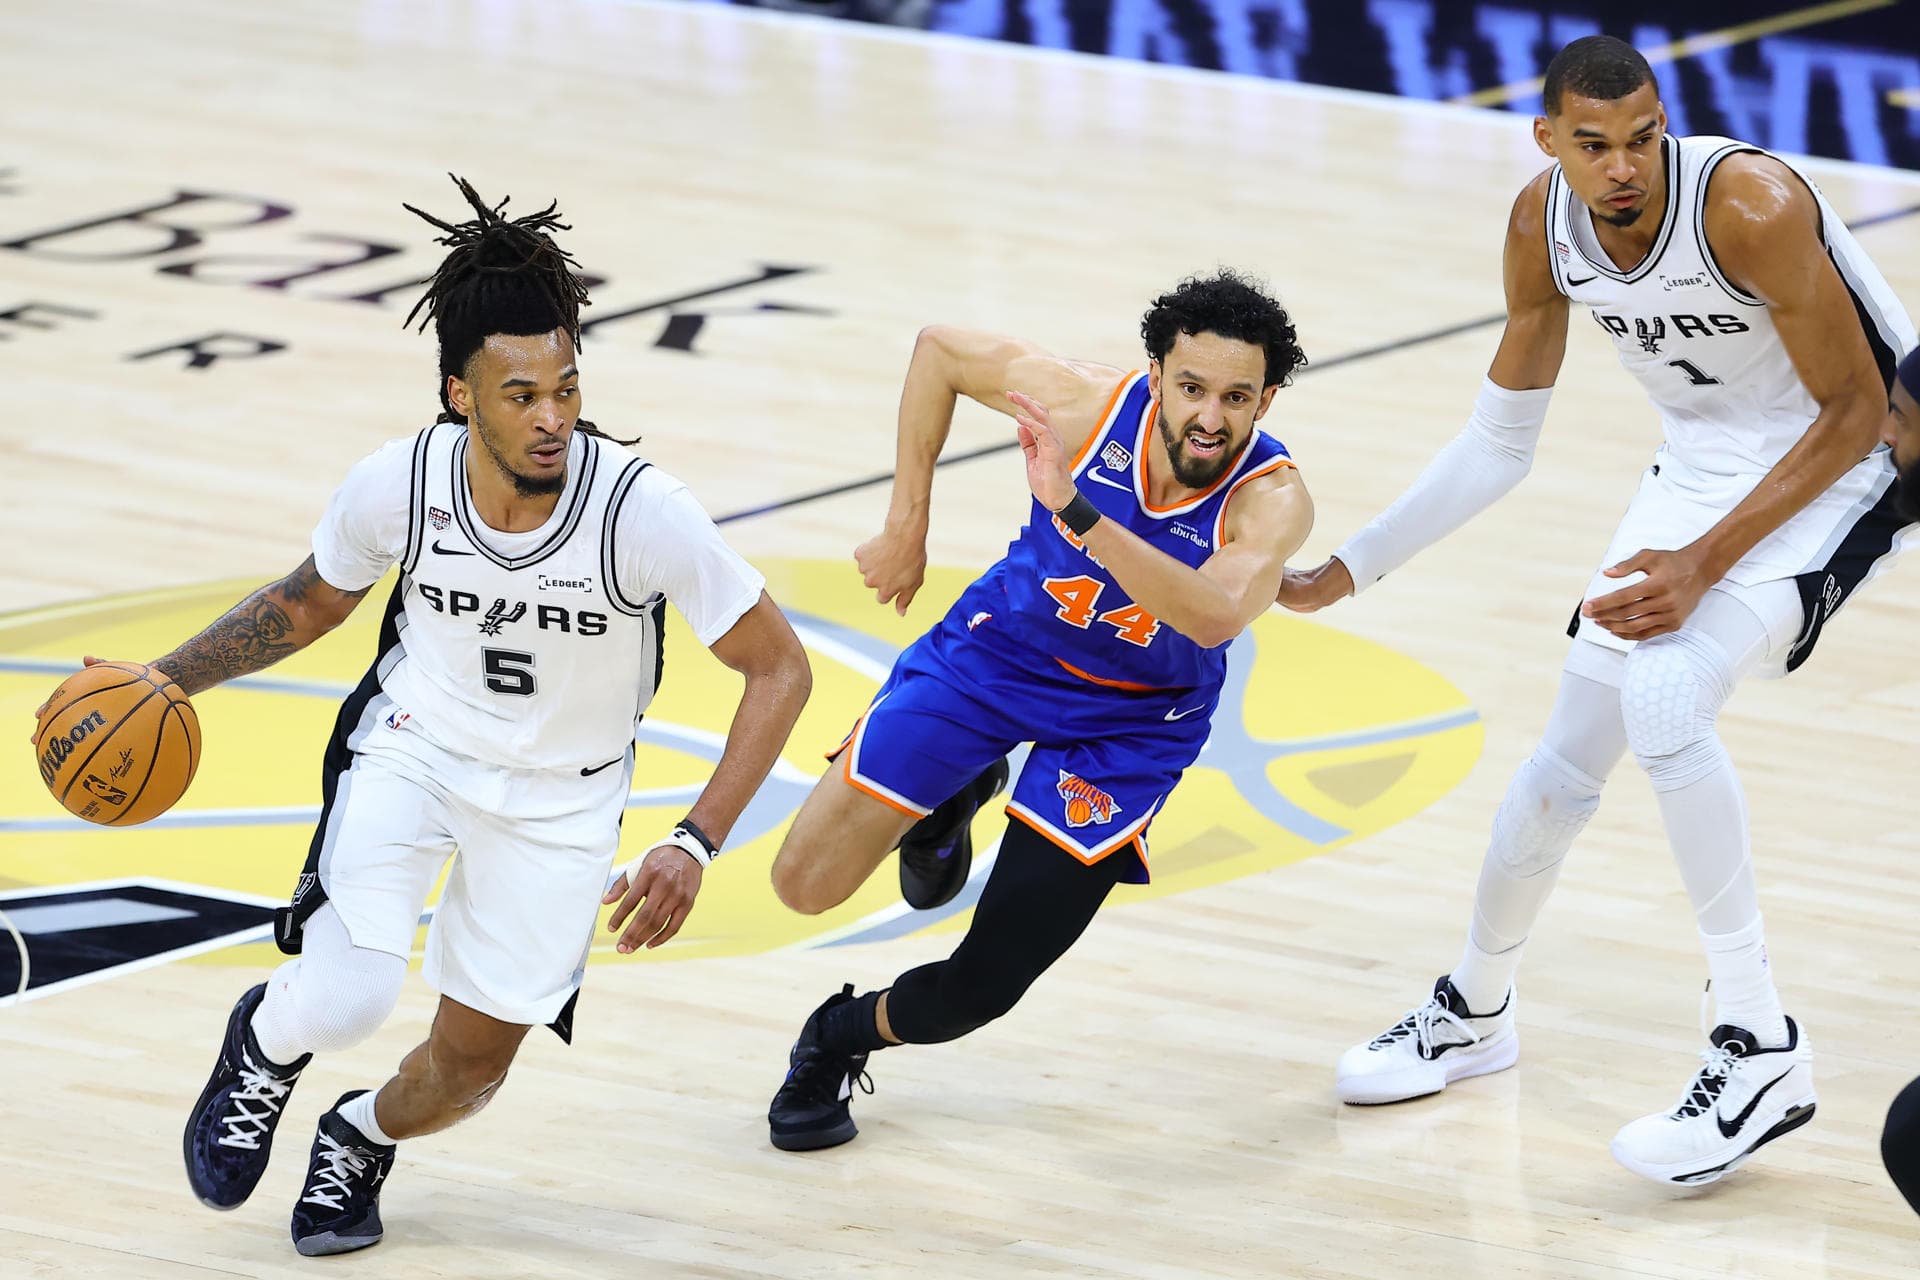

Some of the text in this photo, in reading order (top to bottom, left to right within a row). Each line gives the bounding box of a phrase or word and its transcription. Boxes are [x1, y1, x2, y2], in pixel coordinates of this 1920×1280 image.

[1666, 277, 1703, 287] LEDGER
[1665, 358, 1724, 386] 1
[544, 578, 586, 590] LEDGER
[1042, 575, 1160, 647] 44
[481, 645, 538, 698] 5
[1058, 775, 1112, 821] KNICKS
